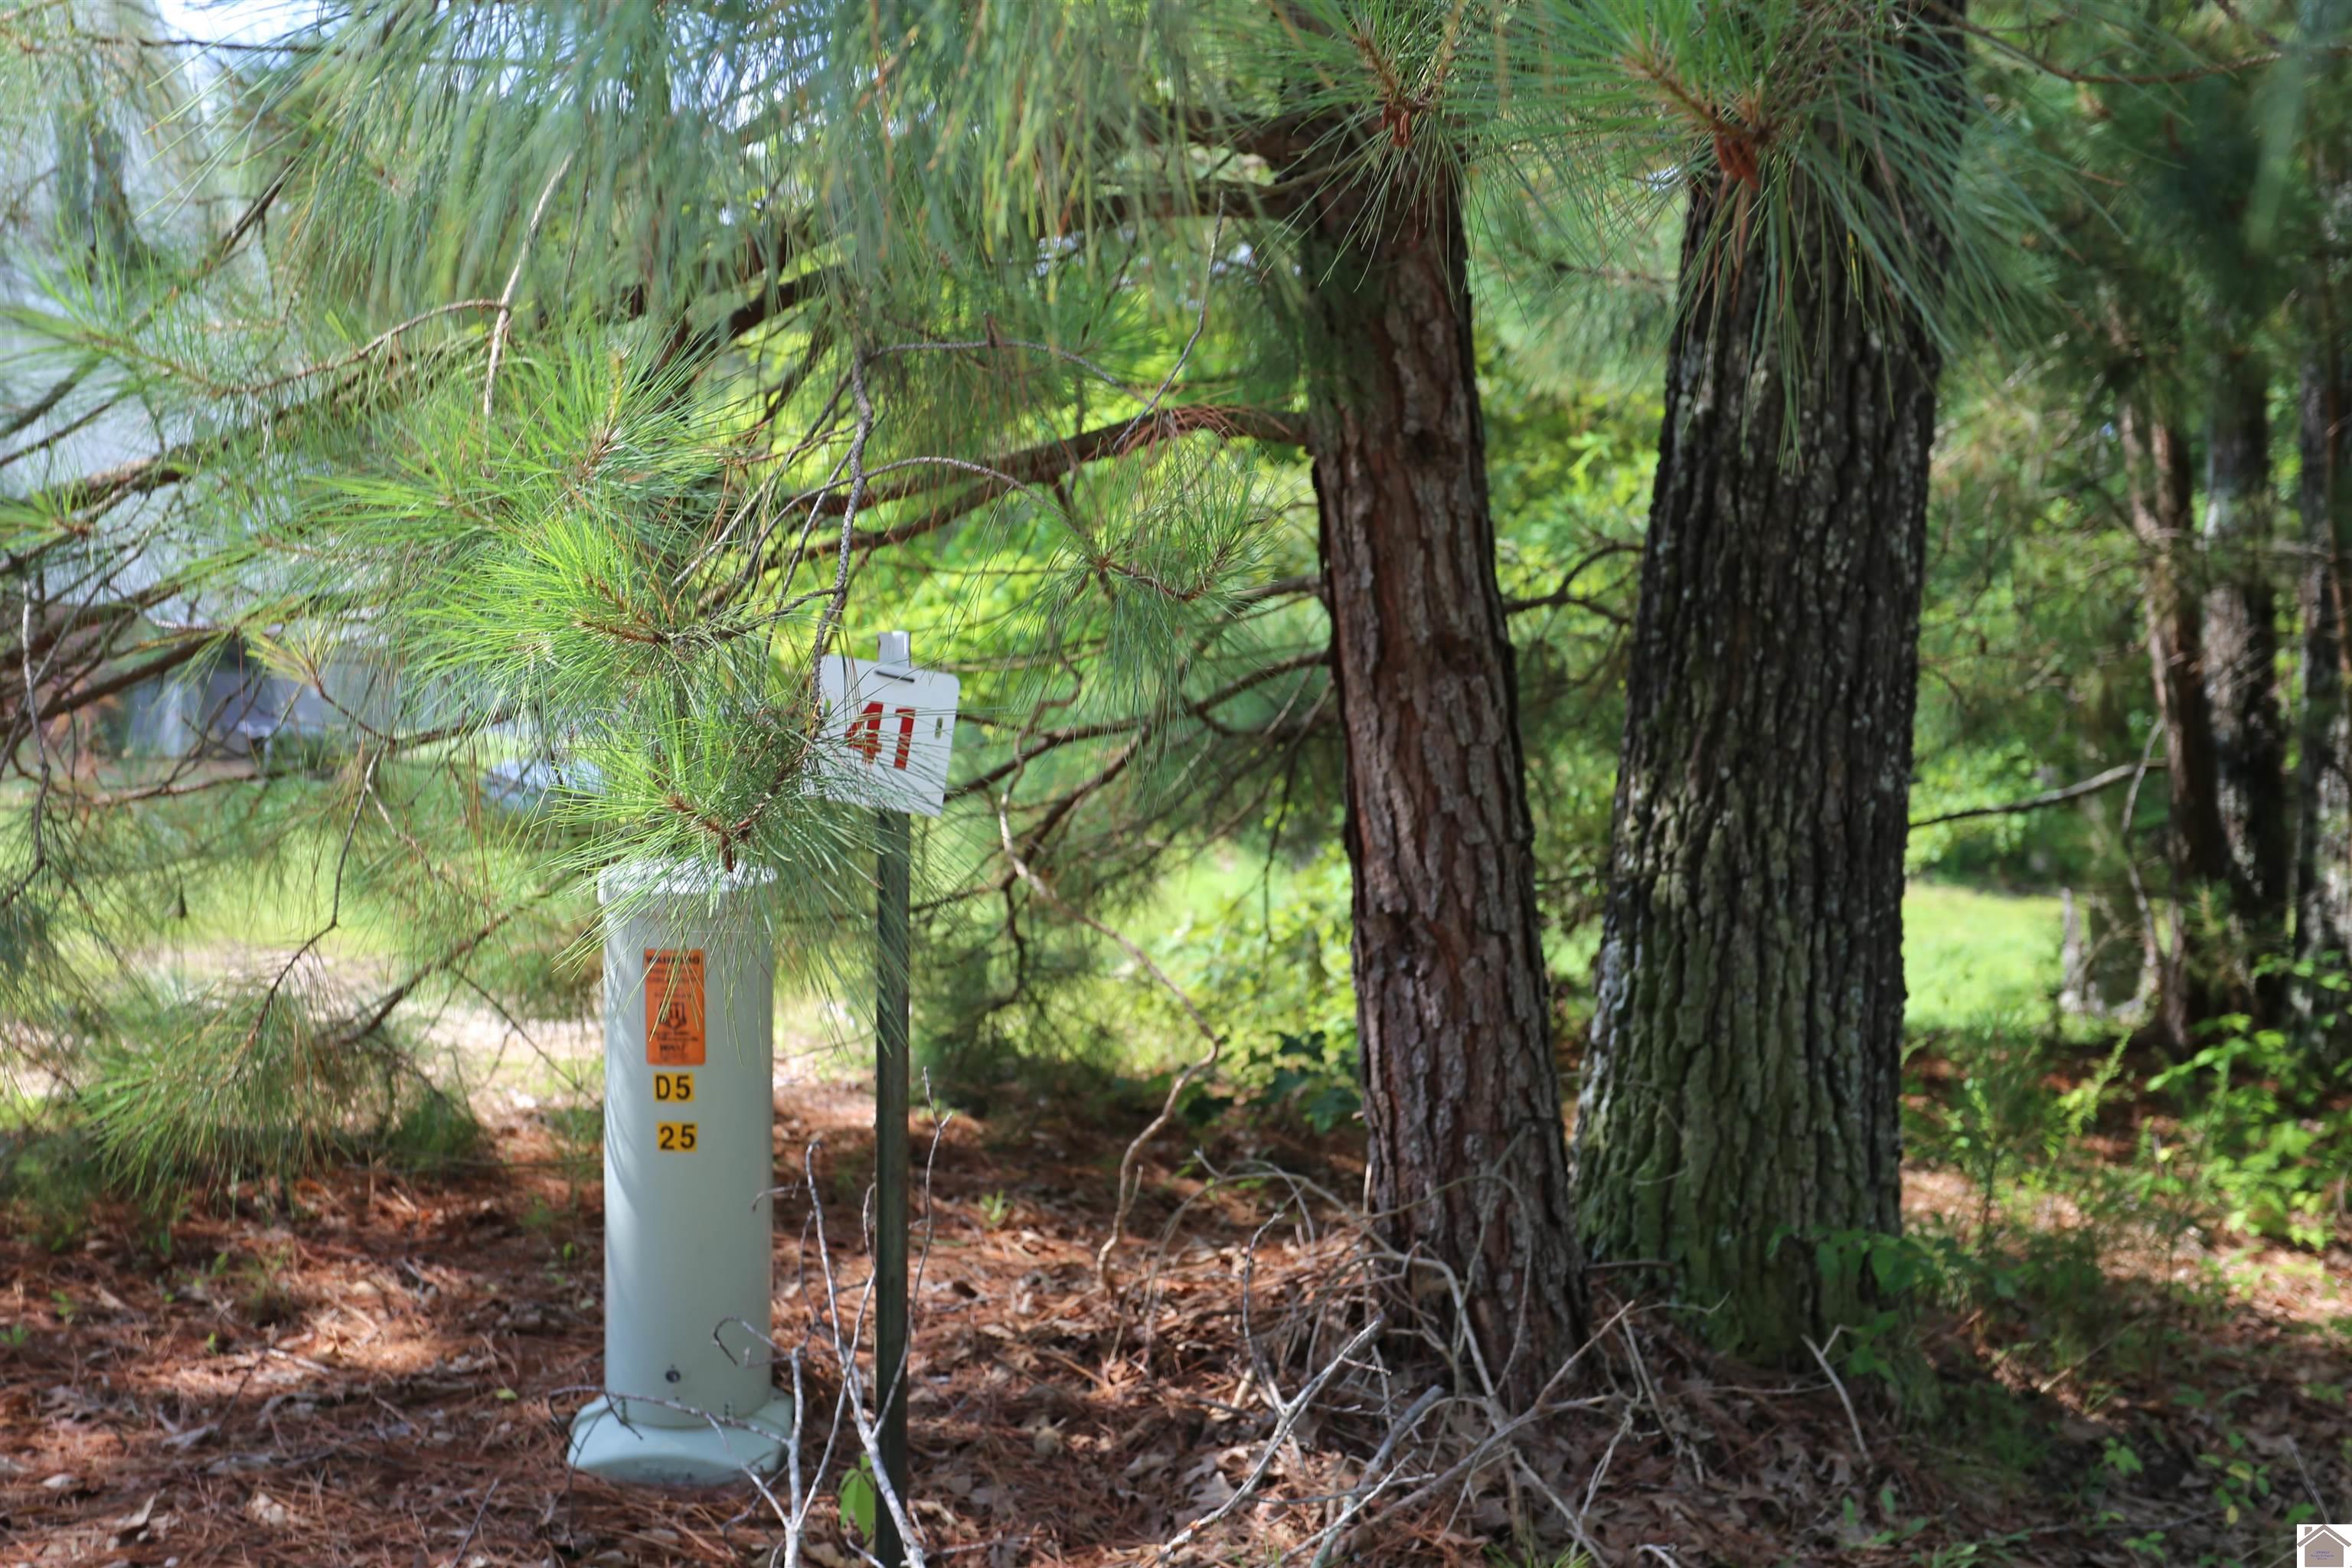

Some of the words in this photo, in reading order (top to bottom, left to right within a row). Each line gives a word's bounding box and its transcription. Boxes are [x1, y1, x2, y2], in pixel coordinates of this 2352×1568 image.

[844, 702, 916, 770] 41
[655, 1075, 691, 1100] D5
[659, 1124, 695, 1150] 25
